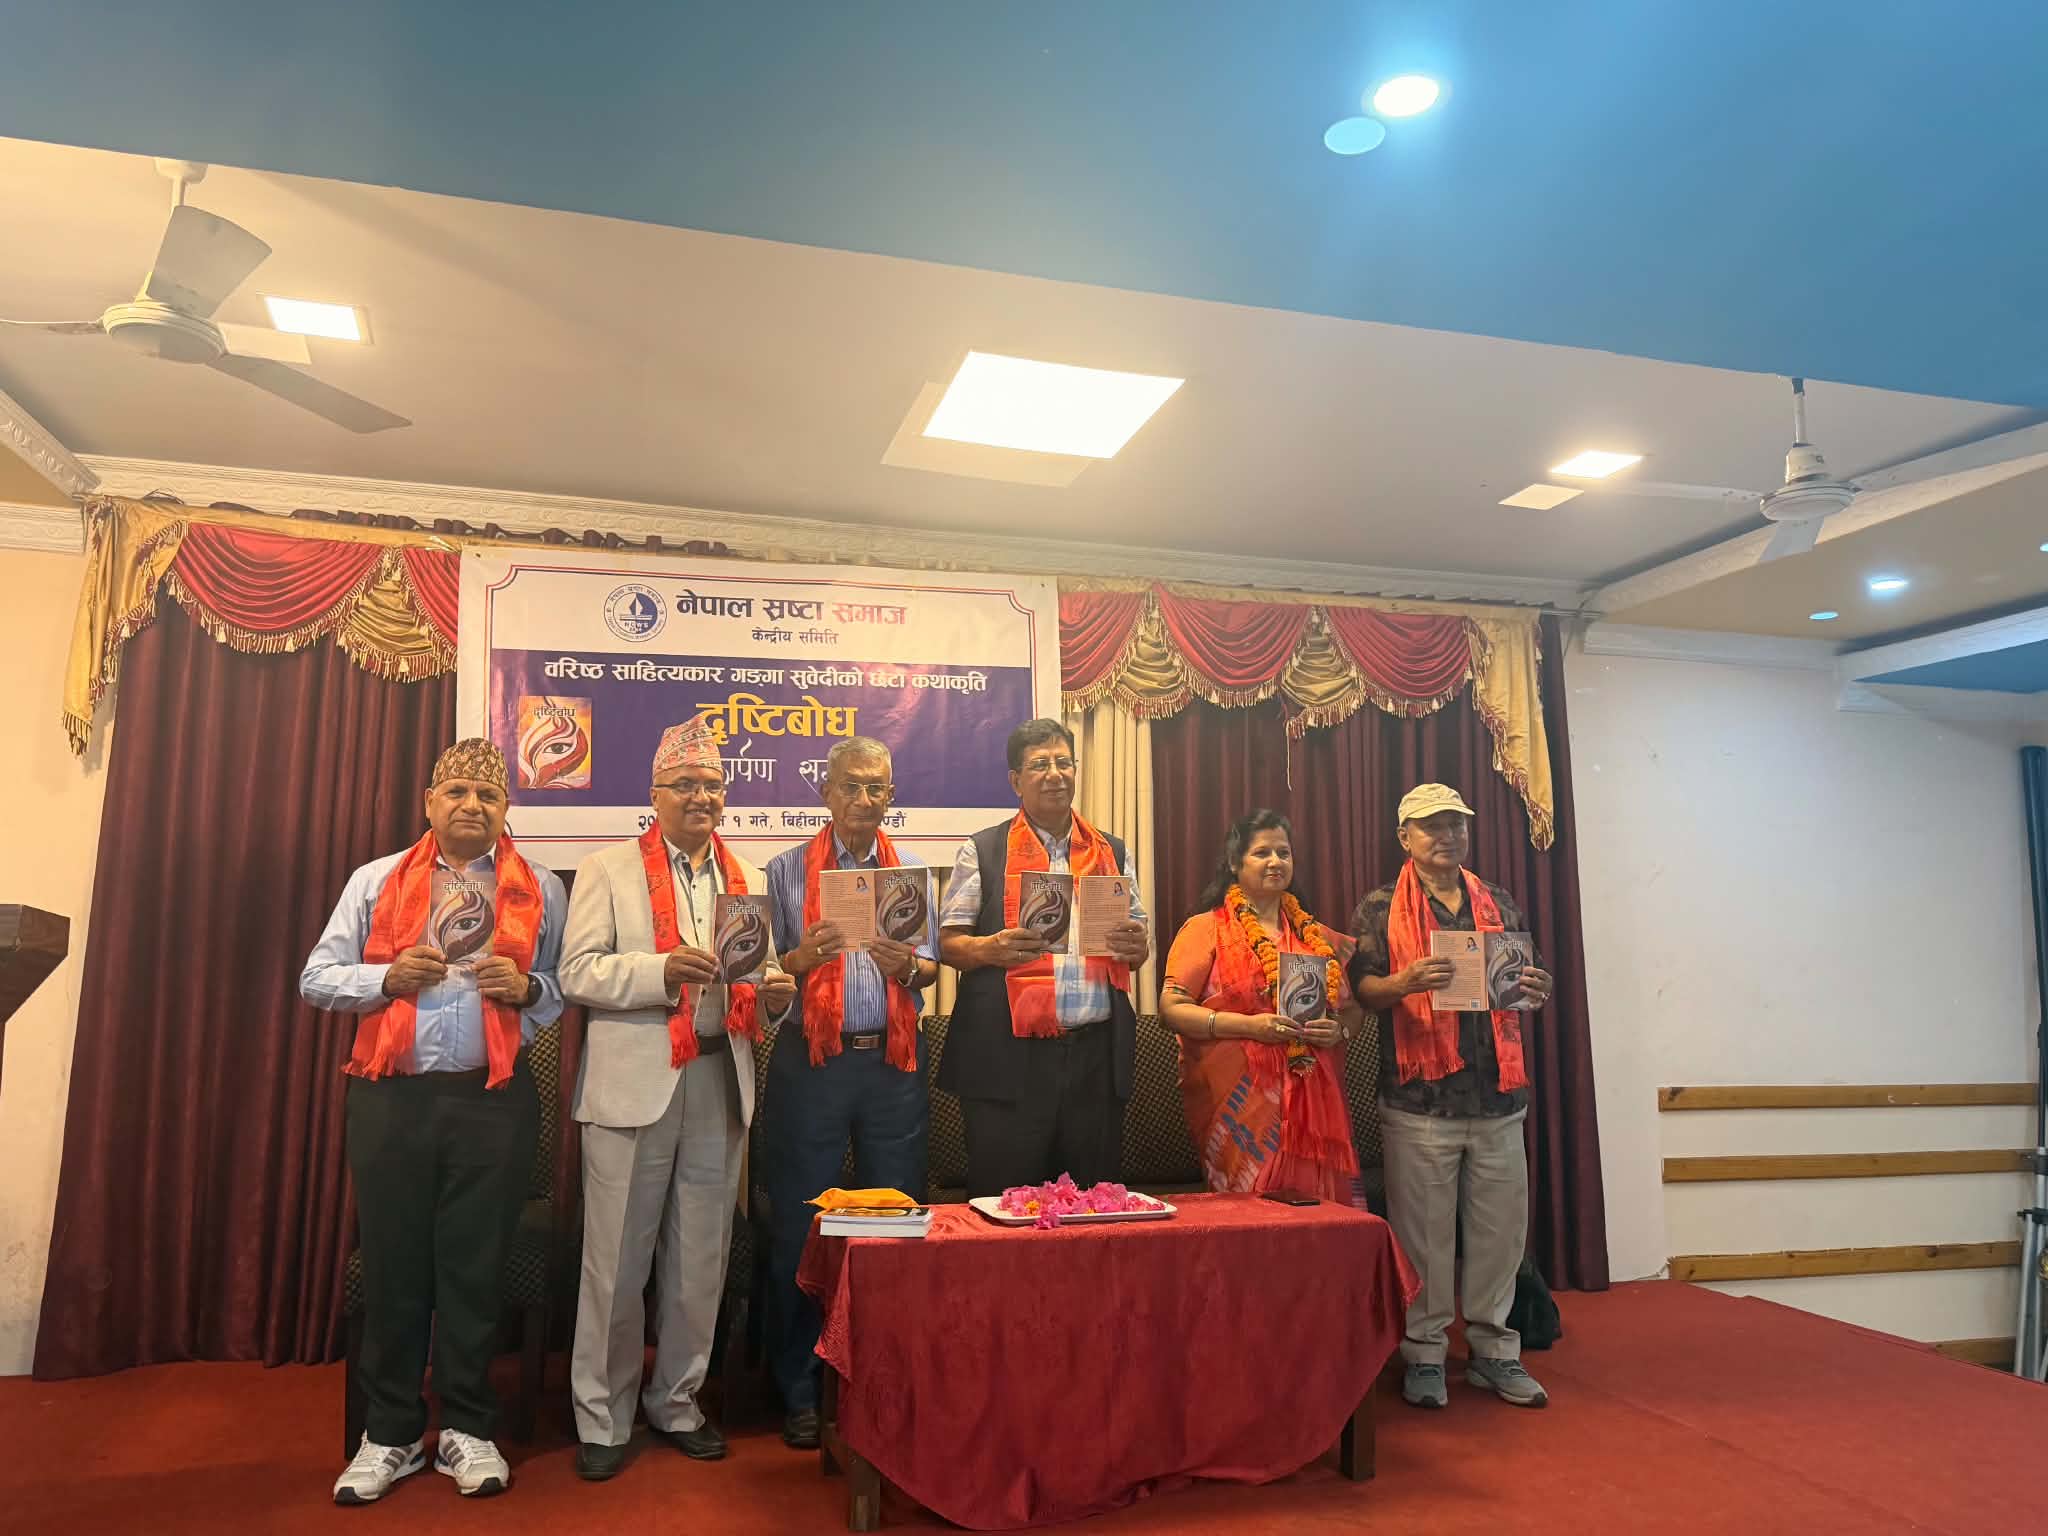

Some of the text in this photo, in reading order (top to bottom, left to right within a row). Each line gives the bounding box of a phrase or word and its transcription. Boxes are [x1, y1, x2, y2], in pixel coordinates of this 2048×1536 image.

[675, 589, 754, 618] नेपाल
[832, 602, 908, 625] समाज
[752, 627, 839, 645] केन्द्रीय समिति
[544, 657, 606, 680] वरिष्ठ
[611, 660, 724, 683] साहित्यकार
[790, 666, 864, 689] सुवेदीको
[912, 671, 988, 695] कथाकृति
[696, 693, 858, 745] दृष्टिबोध
